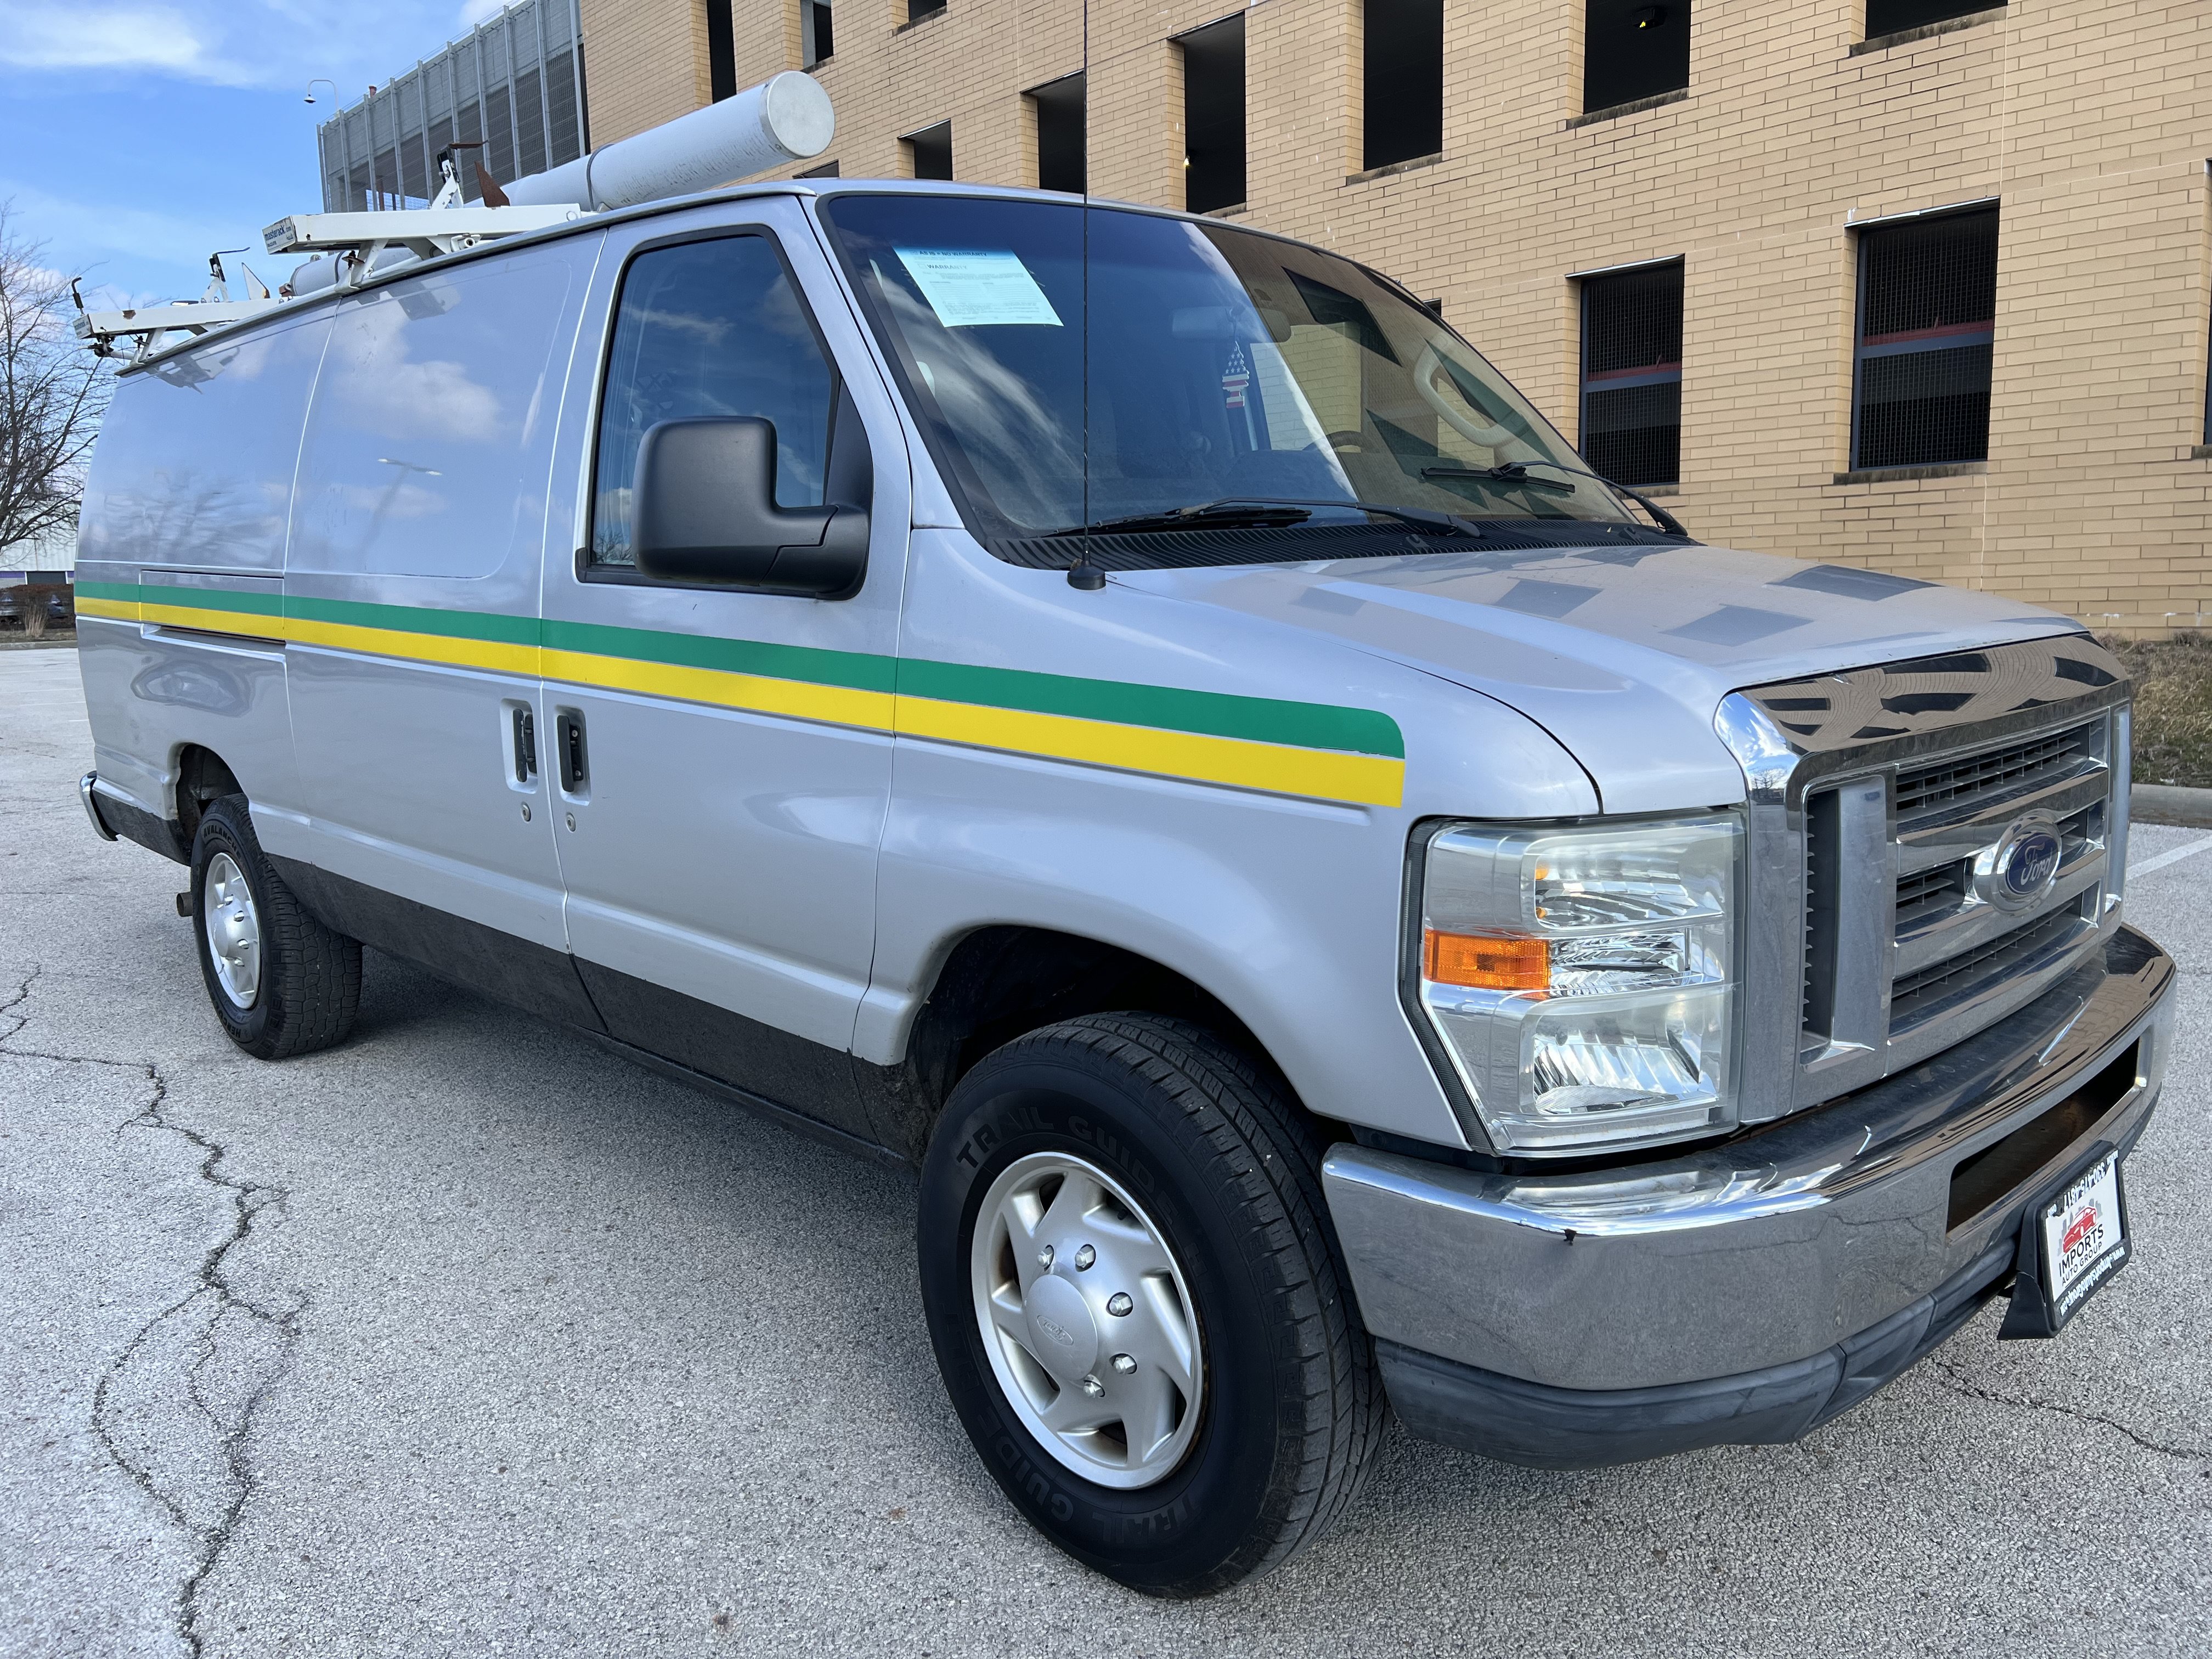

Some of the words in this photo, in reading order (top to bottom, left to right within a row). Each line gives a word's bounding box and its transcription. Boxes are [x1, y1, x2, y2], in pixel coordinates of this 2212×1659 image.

[204, 825, 241, 860] AVALANCHE
[2020, 842, 2053, 885] Ford
[956, 1107, 1055, 1169] TRAIL
[1068, 1115, 1180, 1226] GUIDE
[2063, 1161, 2106, 1213] 330-475-4817
[2058, 1223, 2104, 1278] IMPORTS
[2062, 1264, 2078, 1286] AUTO
[2079, 1241, 2103, 1268] GROUP
[977, 1405, 1074, 1522] GUIDE
[1092, 1493, 1202, 1545] TRAIL
